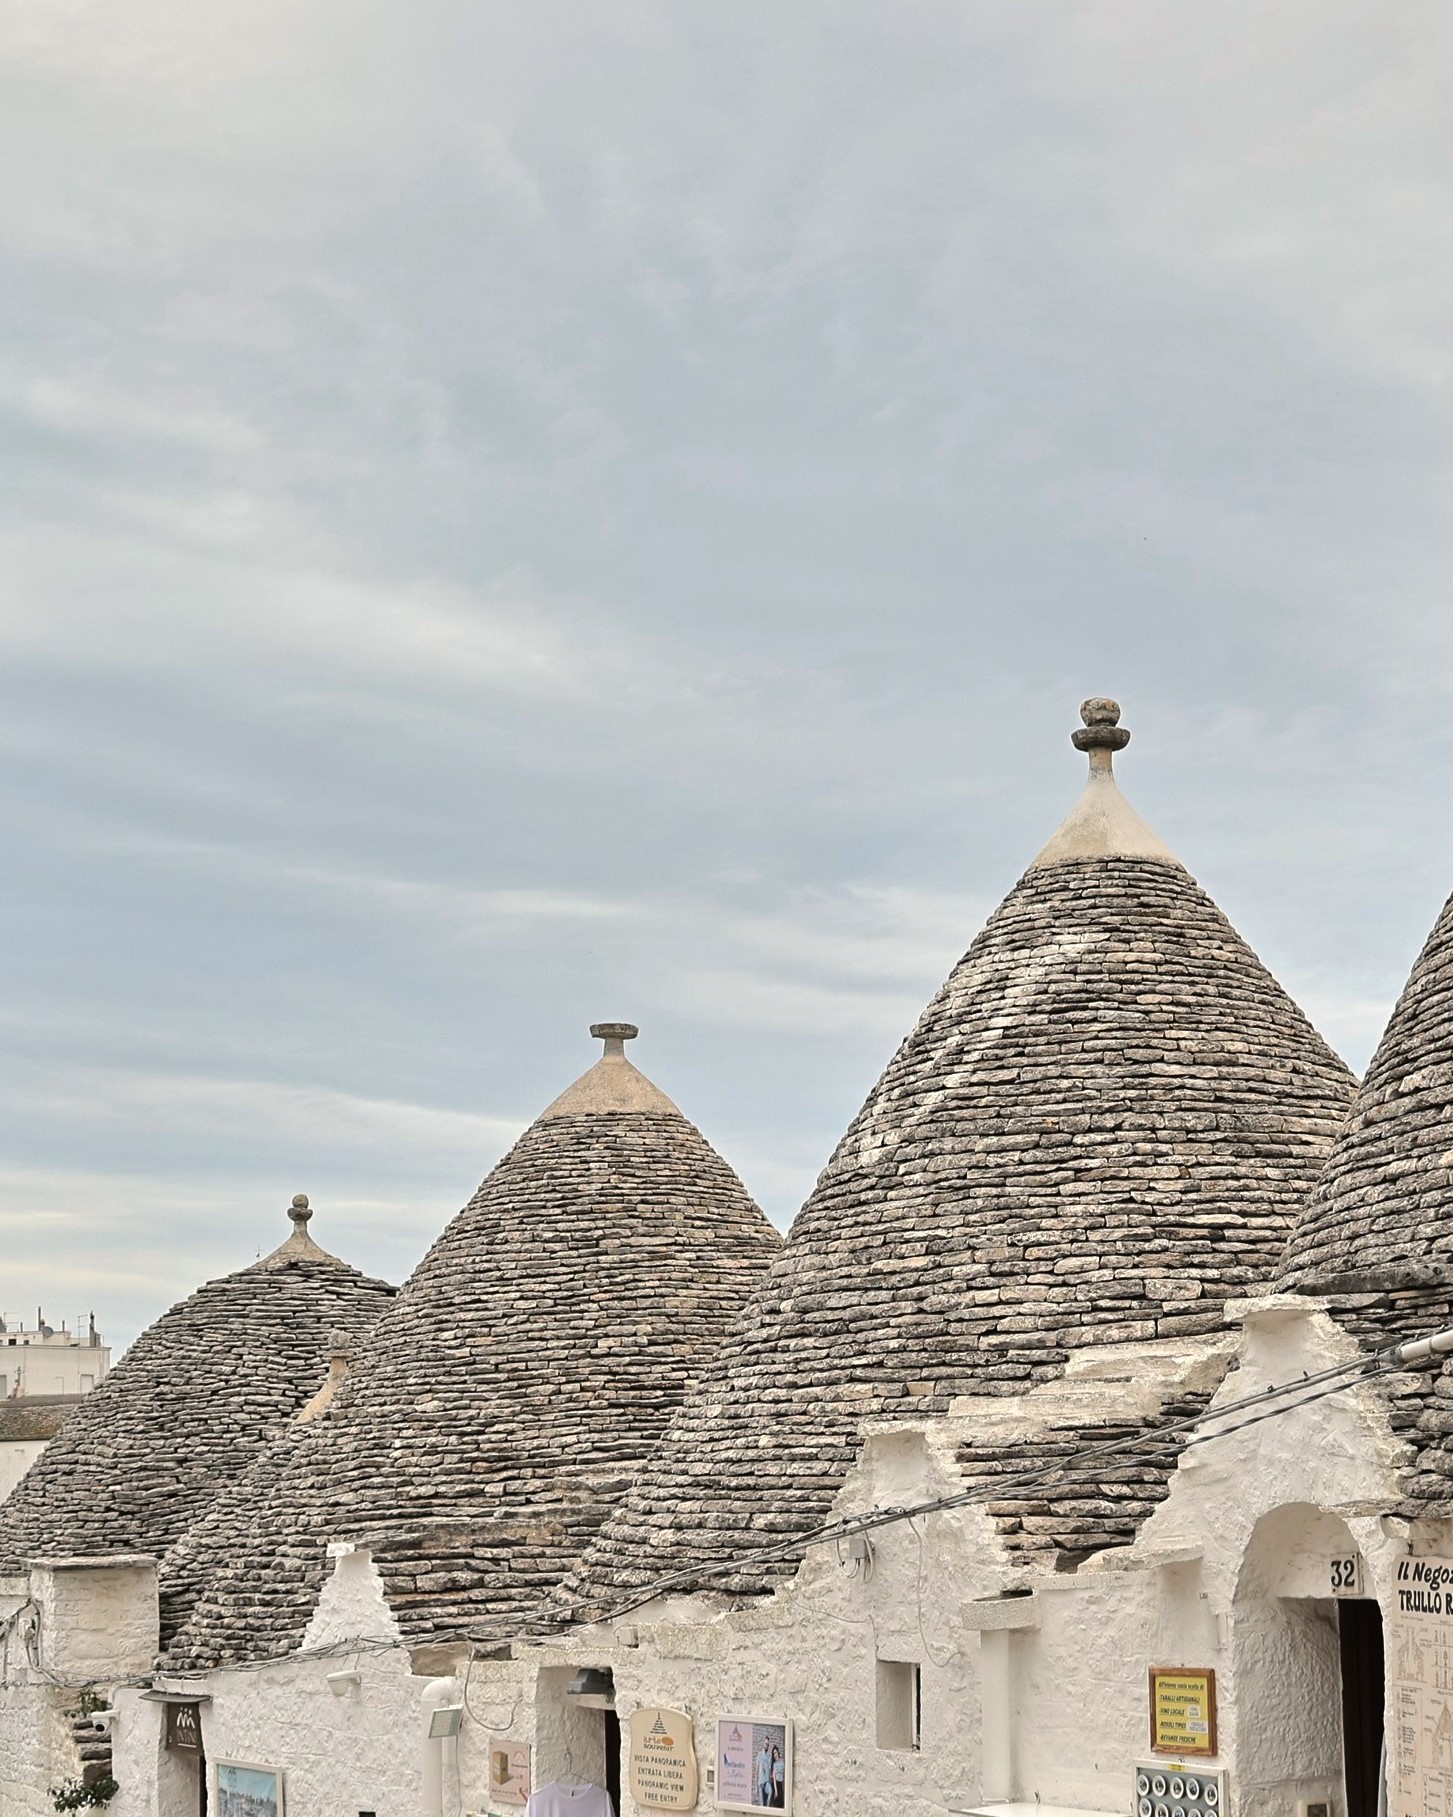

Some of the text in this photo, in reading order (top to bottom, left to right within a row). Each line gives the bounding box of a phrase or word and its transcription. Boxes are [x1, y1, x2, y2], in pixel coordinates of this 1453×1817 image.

[1331, 1560, 1356, 1587] 32
[1398, 1589, 1442, 1610] TRULLO
[643, 1735, 661, 1745] arte
[634, 1755, 686, 1768] VISTA PANORAMICA
[638, 1767, 683, 1780] ENTRATA LIBERA
[638, 1779, 684, 1792] PANORAMIC VIEW
[644, 1791, 678, 1804] FREE ENTRY
